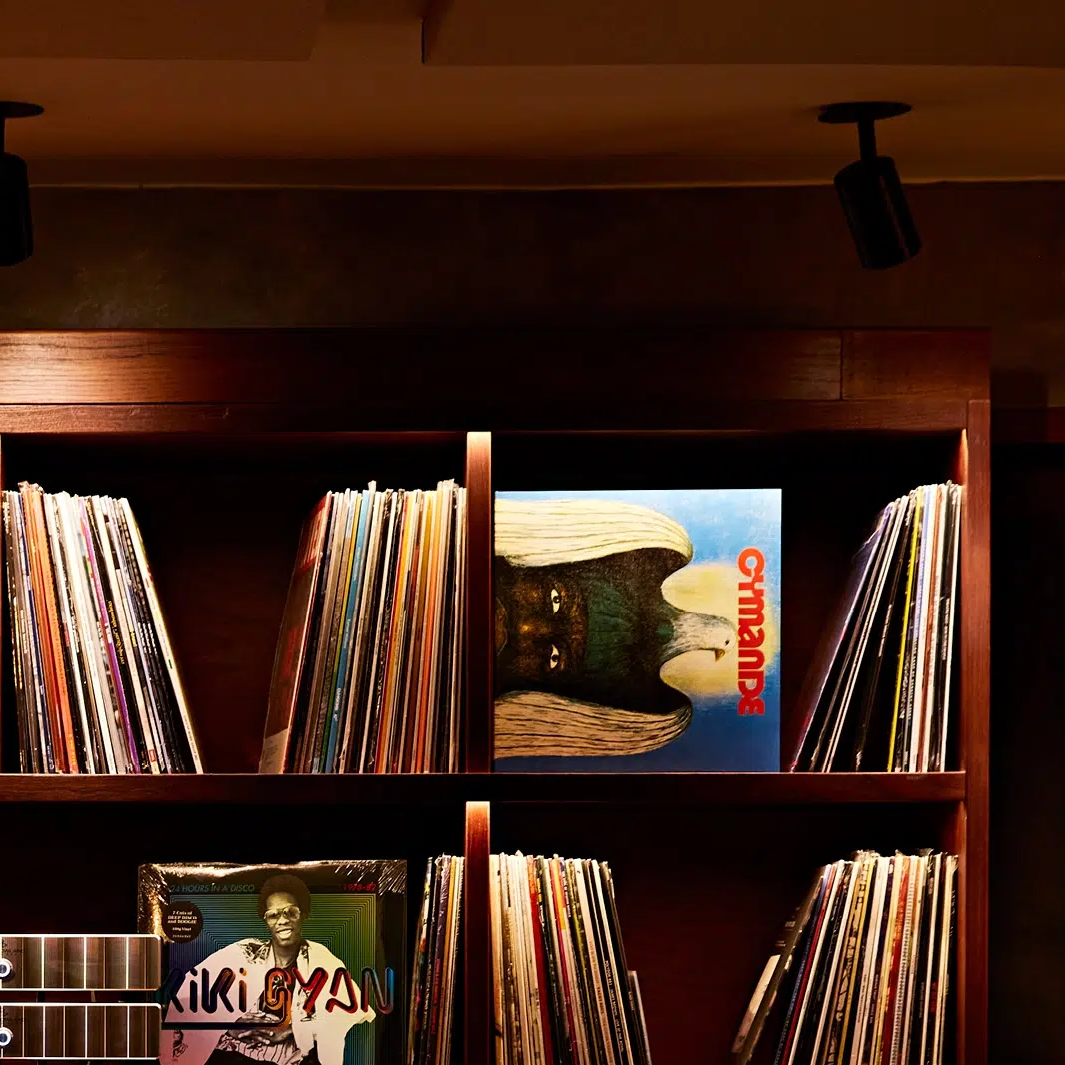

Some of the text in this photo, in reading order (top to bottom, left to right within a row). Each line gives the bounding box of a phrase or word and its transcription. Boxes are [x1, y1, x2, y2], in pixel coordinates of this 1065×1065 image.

[181, 884, 209, 892] HOURS
[210, 884, 220, 892] IN
[230, 884, 255, 892] DISCO
